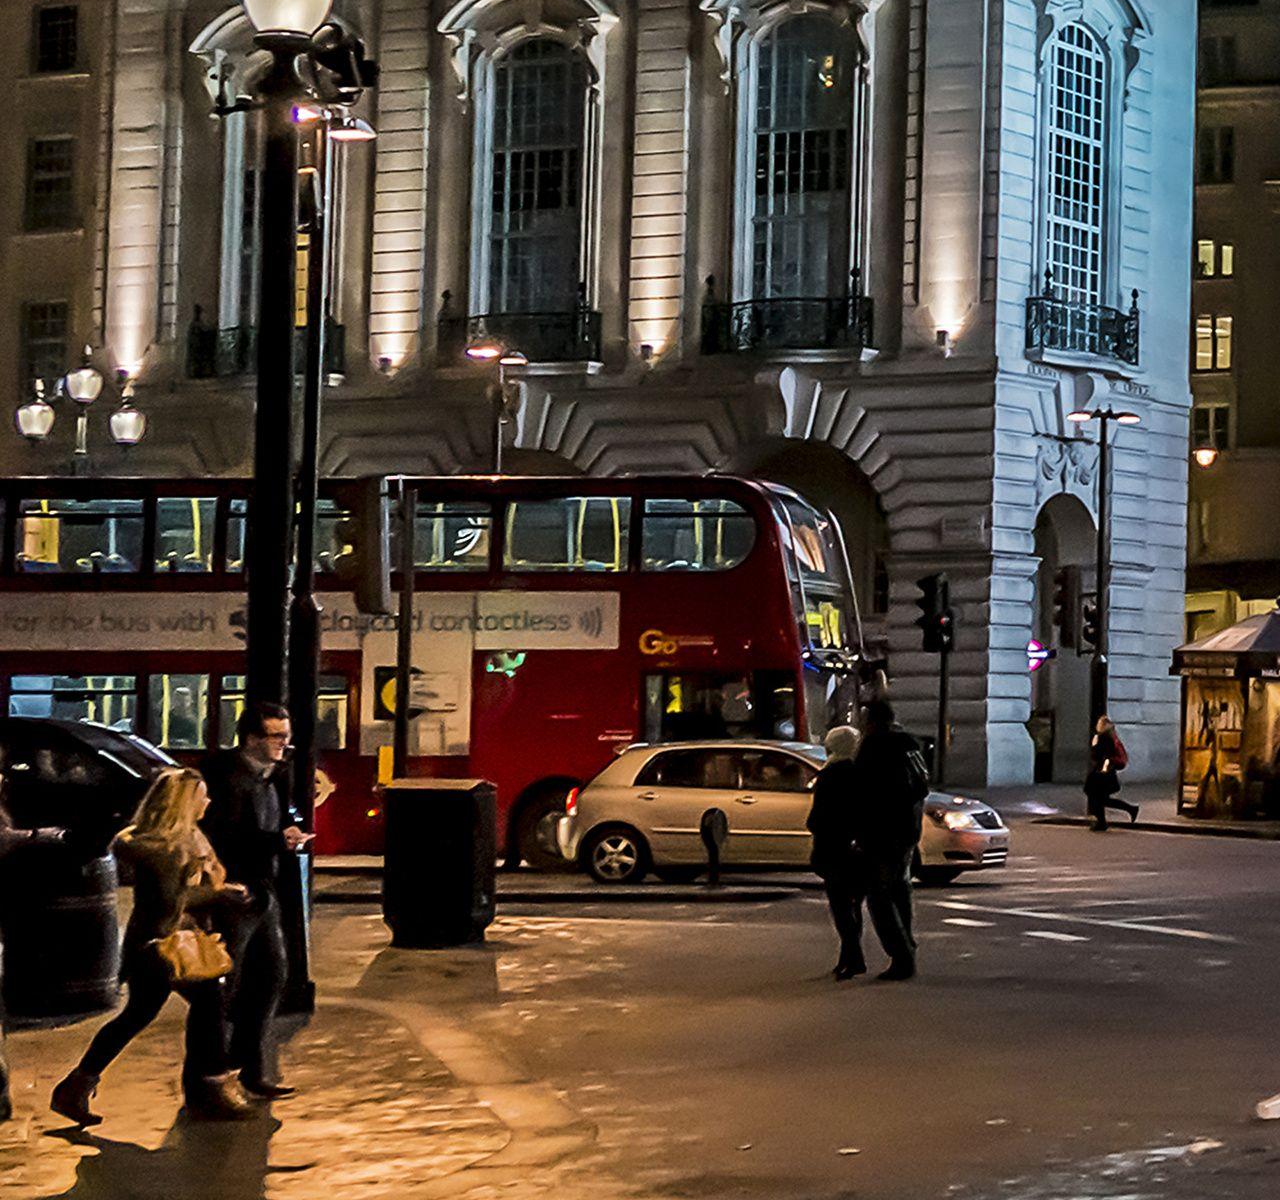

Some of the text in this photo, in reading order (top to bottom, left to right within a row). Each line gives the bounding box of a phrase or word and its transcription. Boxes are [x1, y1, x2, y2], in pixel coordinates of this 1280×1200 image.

[100, 605, 151, 633] bus
[153, 606, 216, 632] with
[430, 608, 572, 634] contactless
[639, 629, 677, 654] Go
